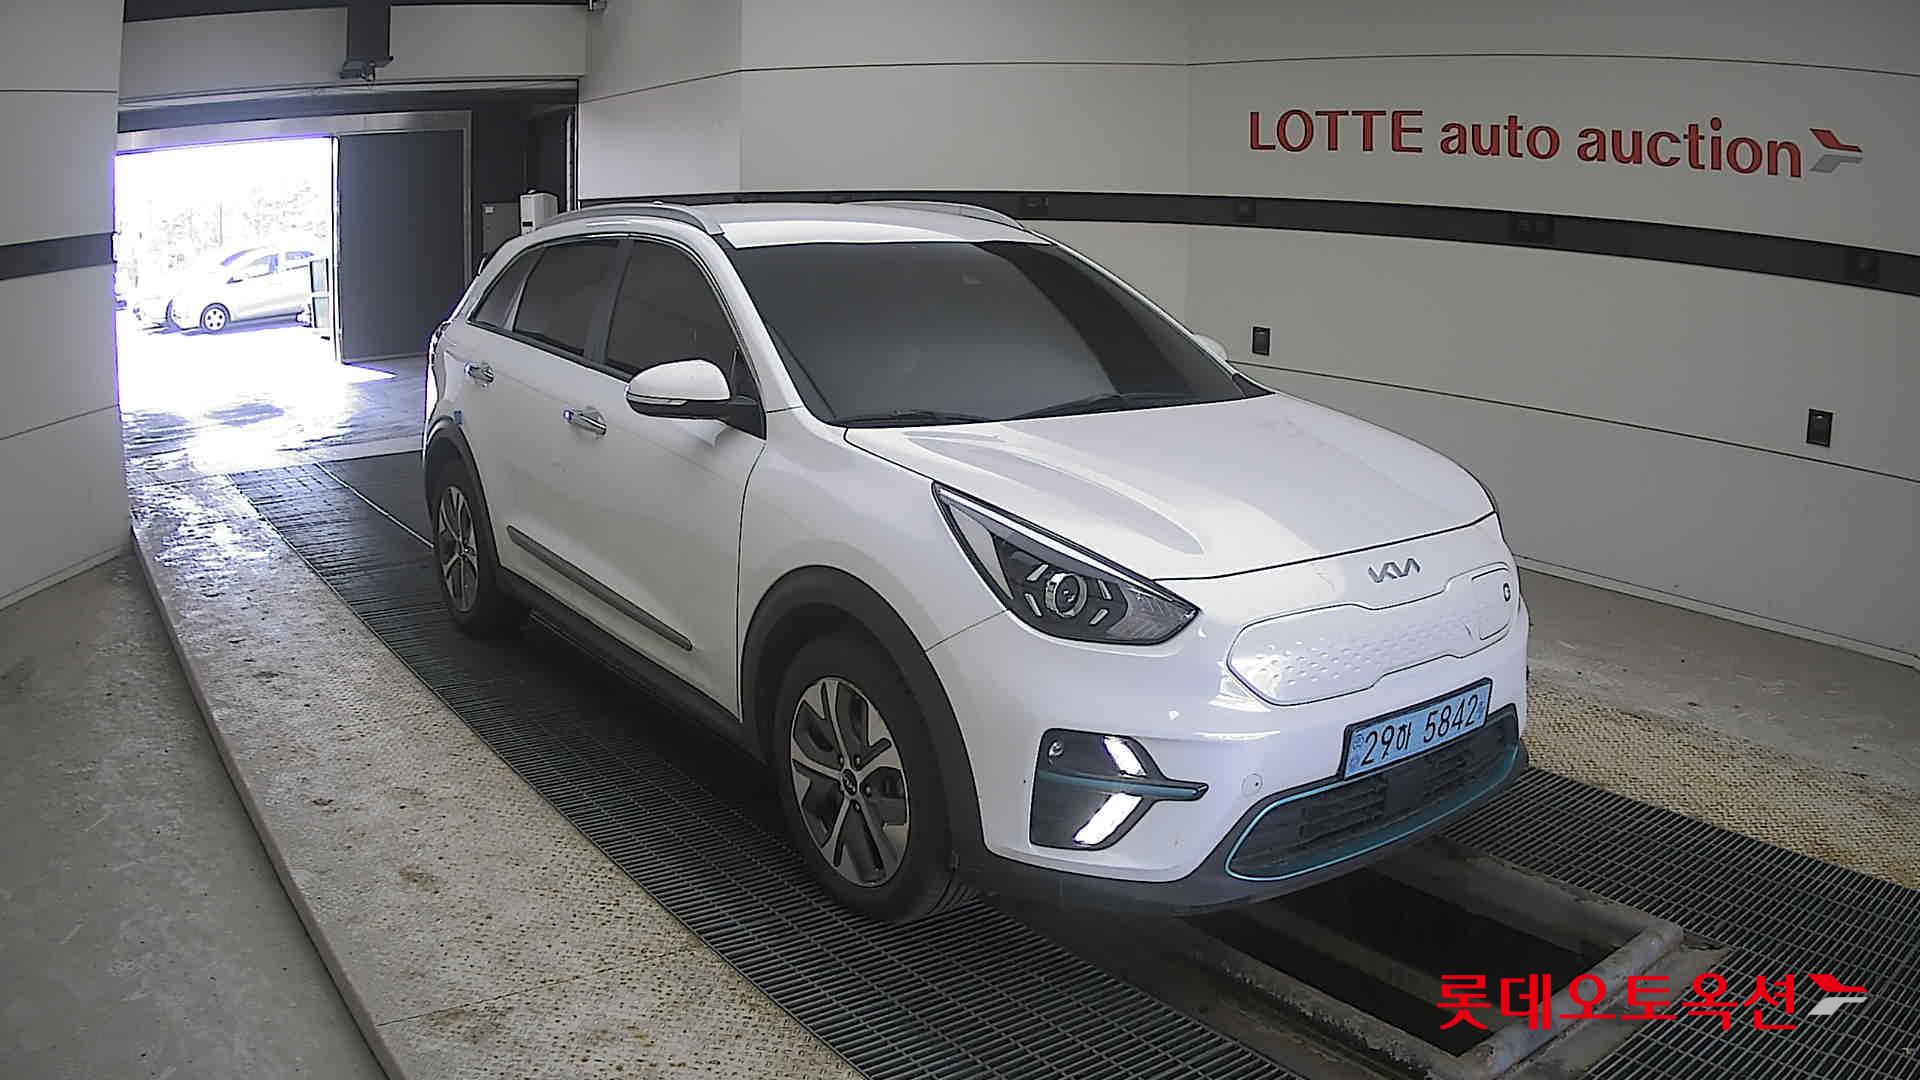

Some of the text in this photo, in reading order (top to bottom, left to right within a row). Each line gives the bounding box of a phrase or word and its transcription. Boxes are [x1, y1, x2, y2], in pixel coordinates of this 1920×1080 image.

[1249, 110, 1802, 177] LOTTE auto auction
[1423, 693, 1480, 743] 5842
